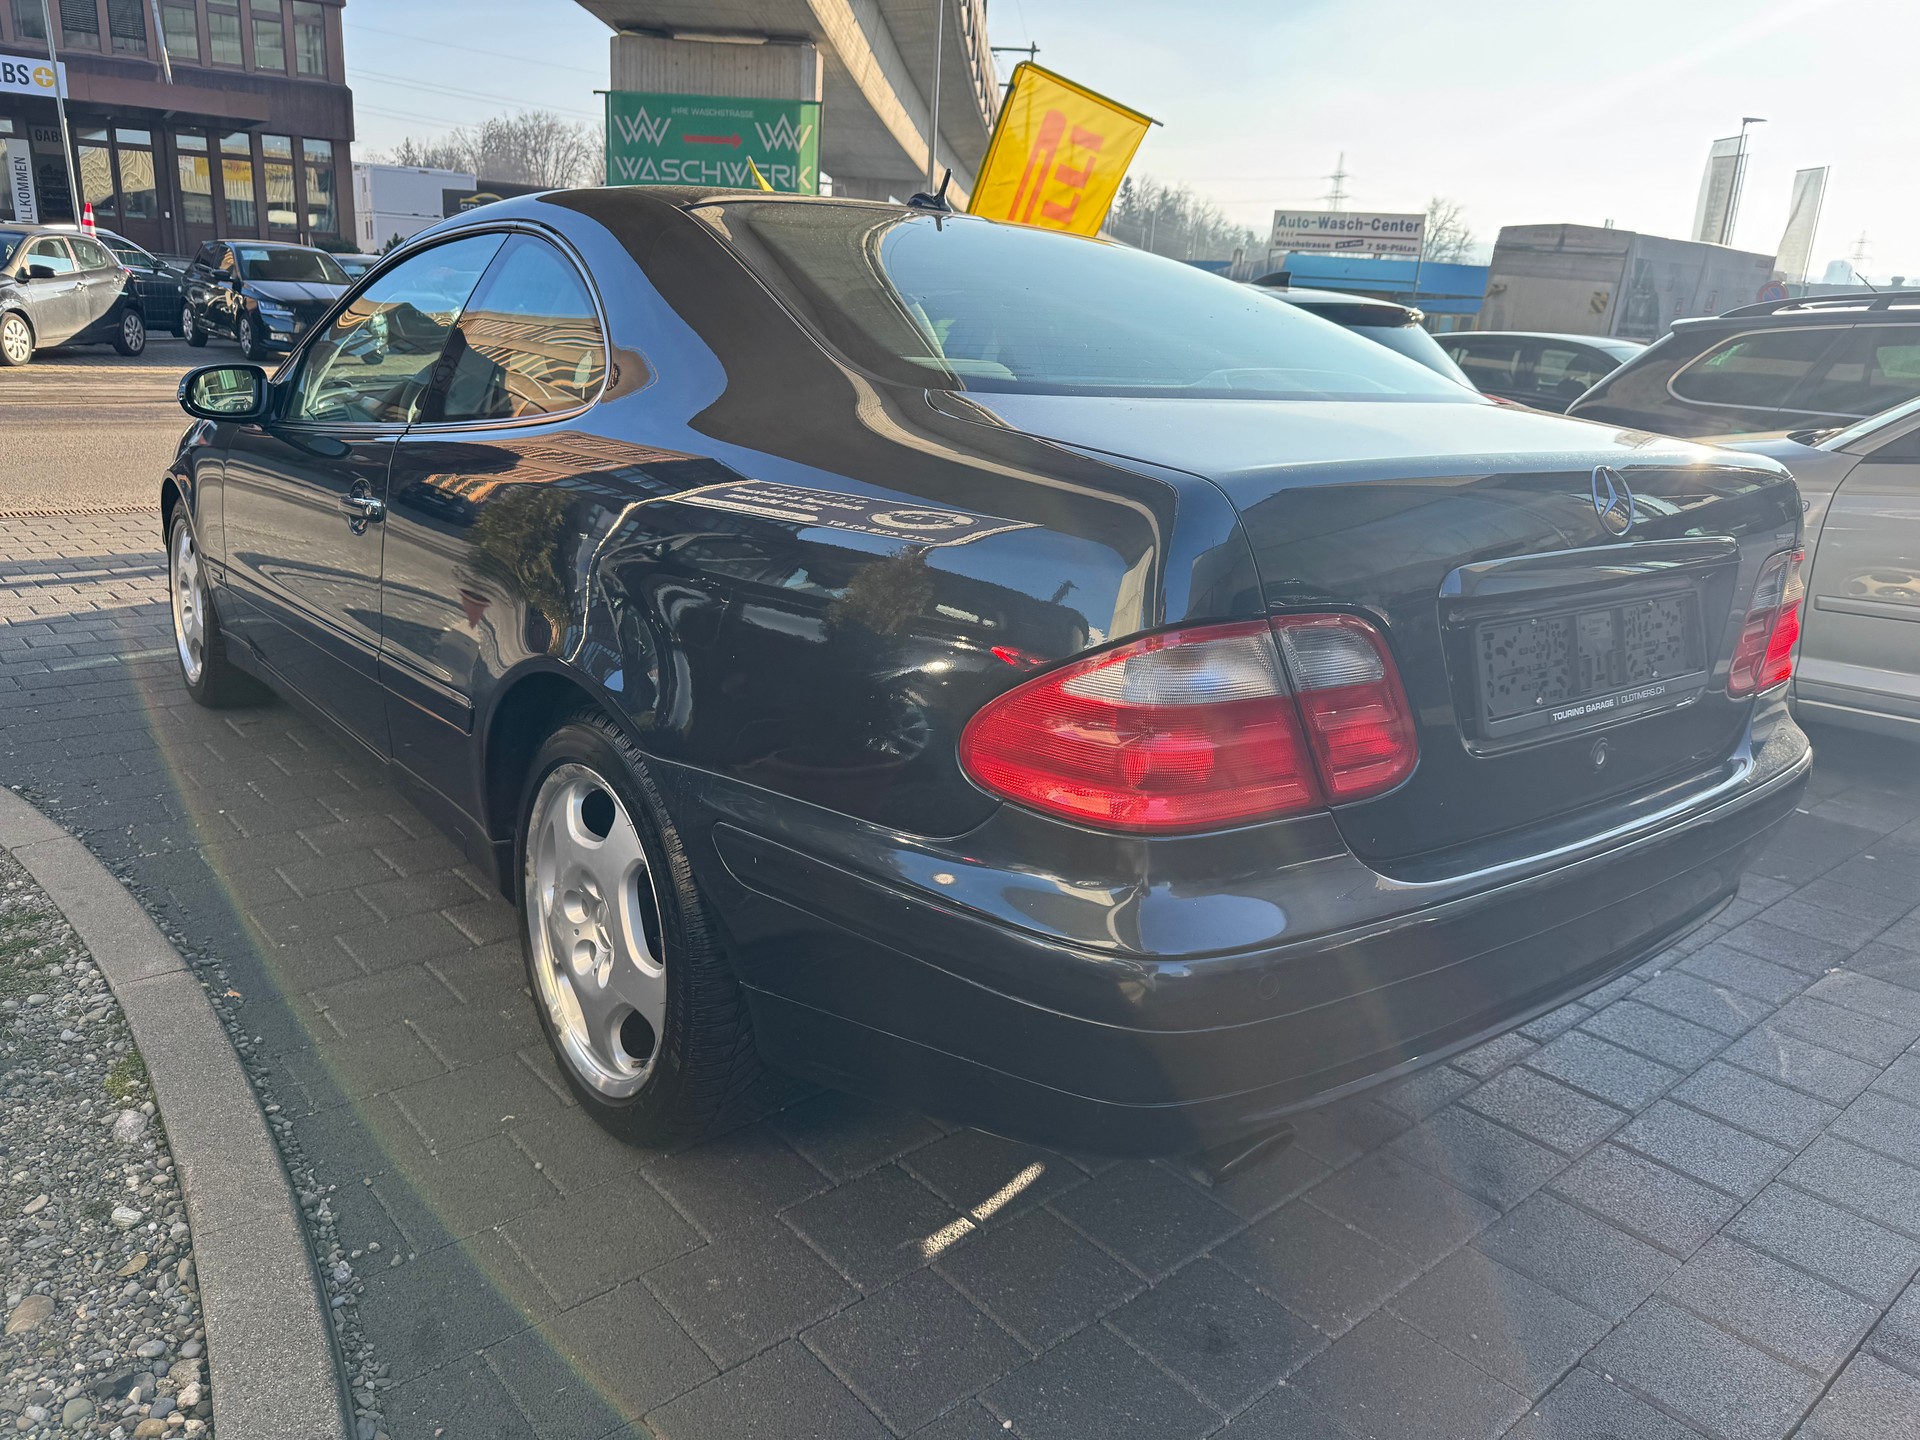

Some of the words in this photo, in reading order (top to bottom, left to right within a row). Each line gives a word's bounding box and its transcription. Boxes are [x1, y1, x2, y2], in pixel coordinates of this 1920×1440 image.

[0, 62, 30, 85] BS
[671, 106, 690, 116] IHRE
[690, 107, 754, 119] WASCHSTRASSE
[614, 155, 812, 190] WASCHWERK
[14, 157, 33, 223] ILLKOMMEN
[1278, 215, 1421, 233] Auto-Wasch-Center
[1552, 706, 1585, 721] TOURING
[1586, 699, 1614, 713] GARAGE
[1621, 686, 1665, 704] OLDTIMERS.CH
